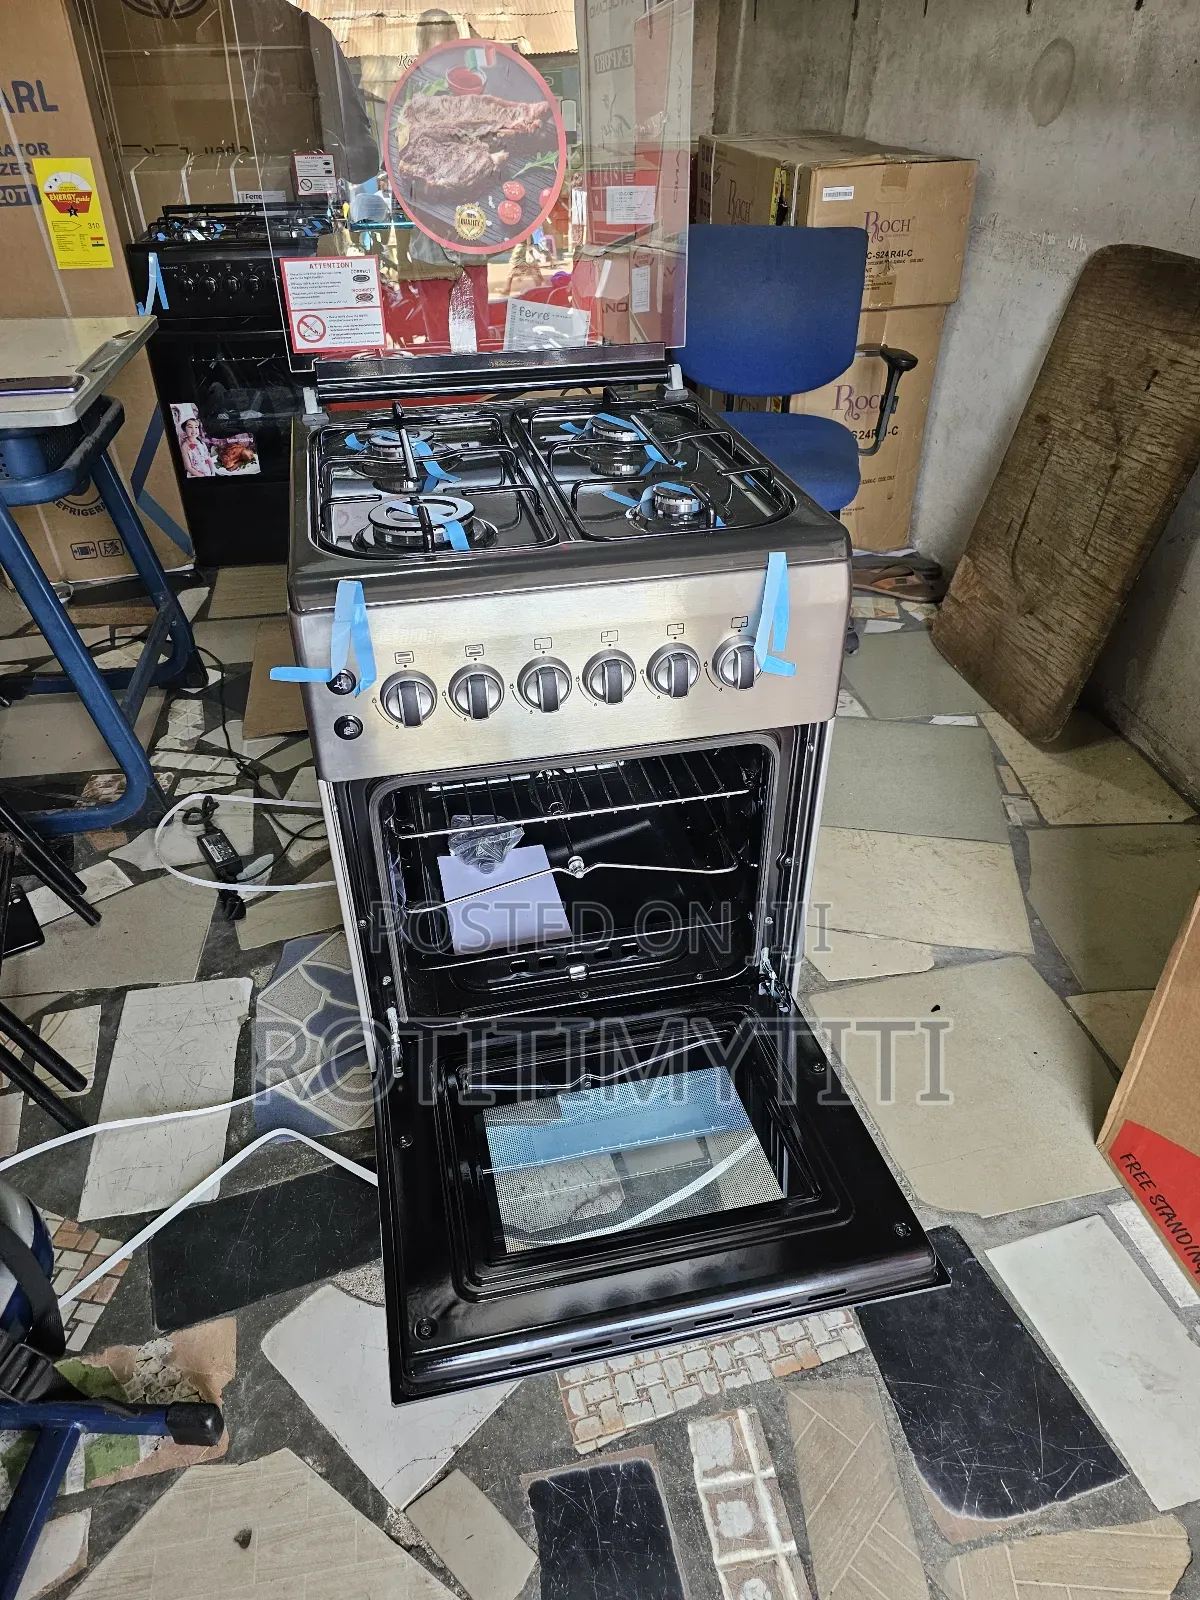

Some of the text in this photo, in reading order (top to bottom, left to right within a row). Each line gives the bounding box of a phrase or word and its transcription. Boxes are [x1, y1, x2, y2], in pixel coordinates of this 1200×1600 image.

[0, 142, 51, 157] ATOR
[48, 192, 76, 202] ENERGY
[87, 222, 101, 230] 310
[460, 218, 481, 226] QUALITY
[309, 261, 353, 269] ATTENTION!
[832, 384, 883, 422] ROC
[53, 499, 106, 517] EFRIGER
[1119, 1152, 1157, 1192] FREE
